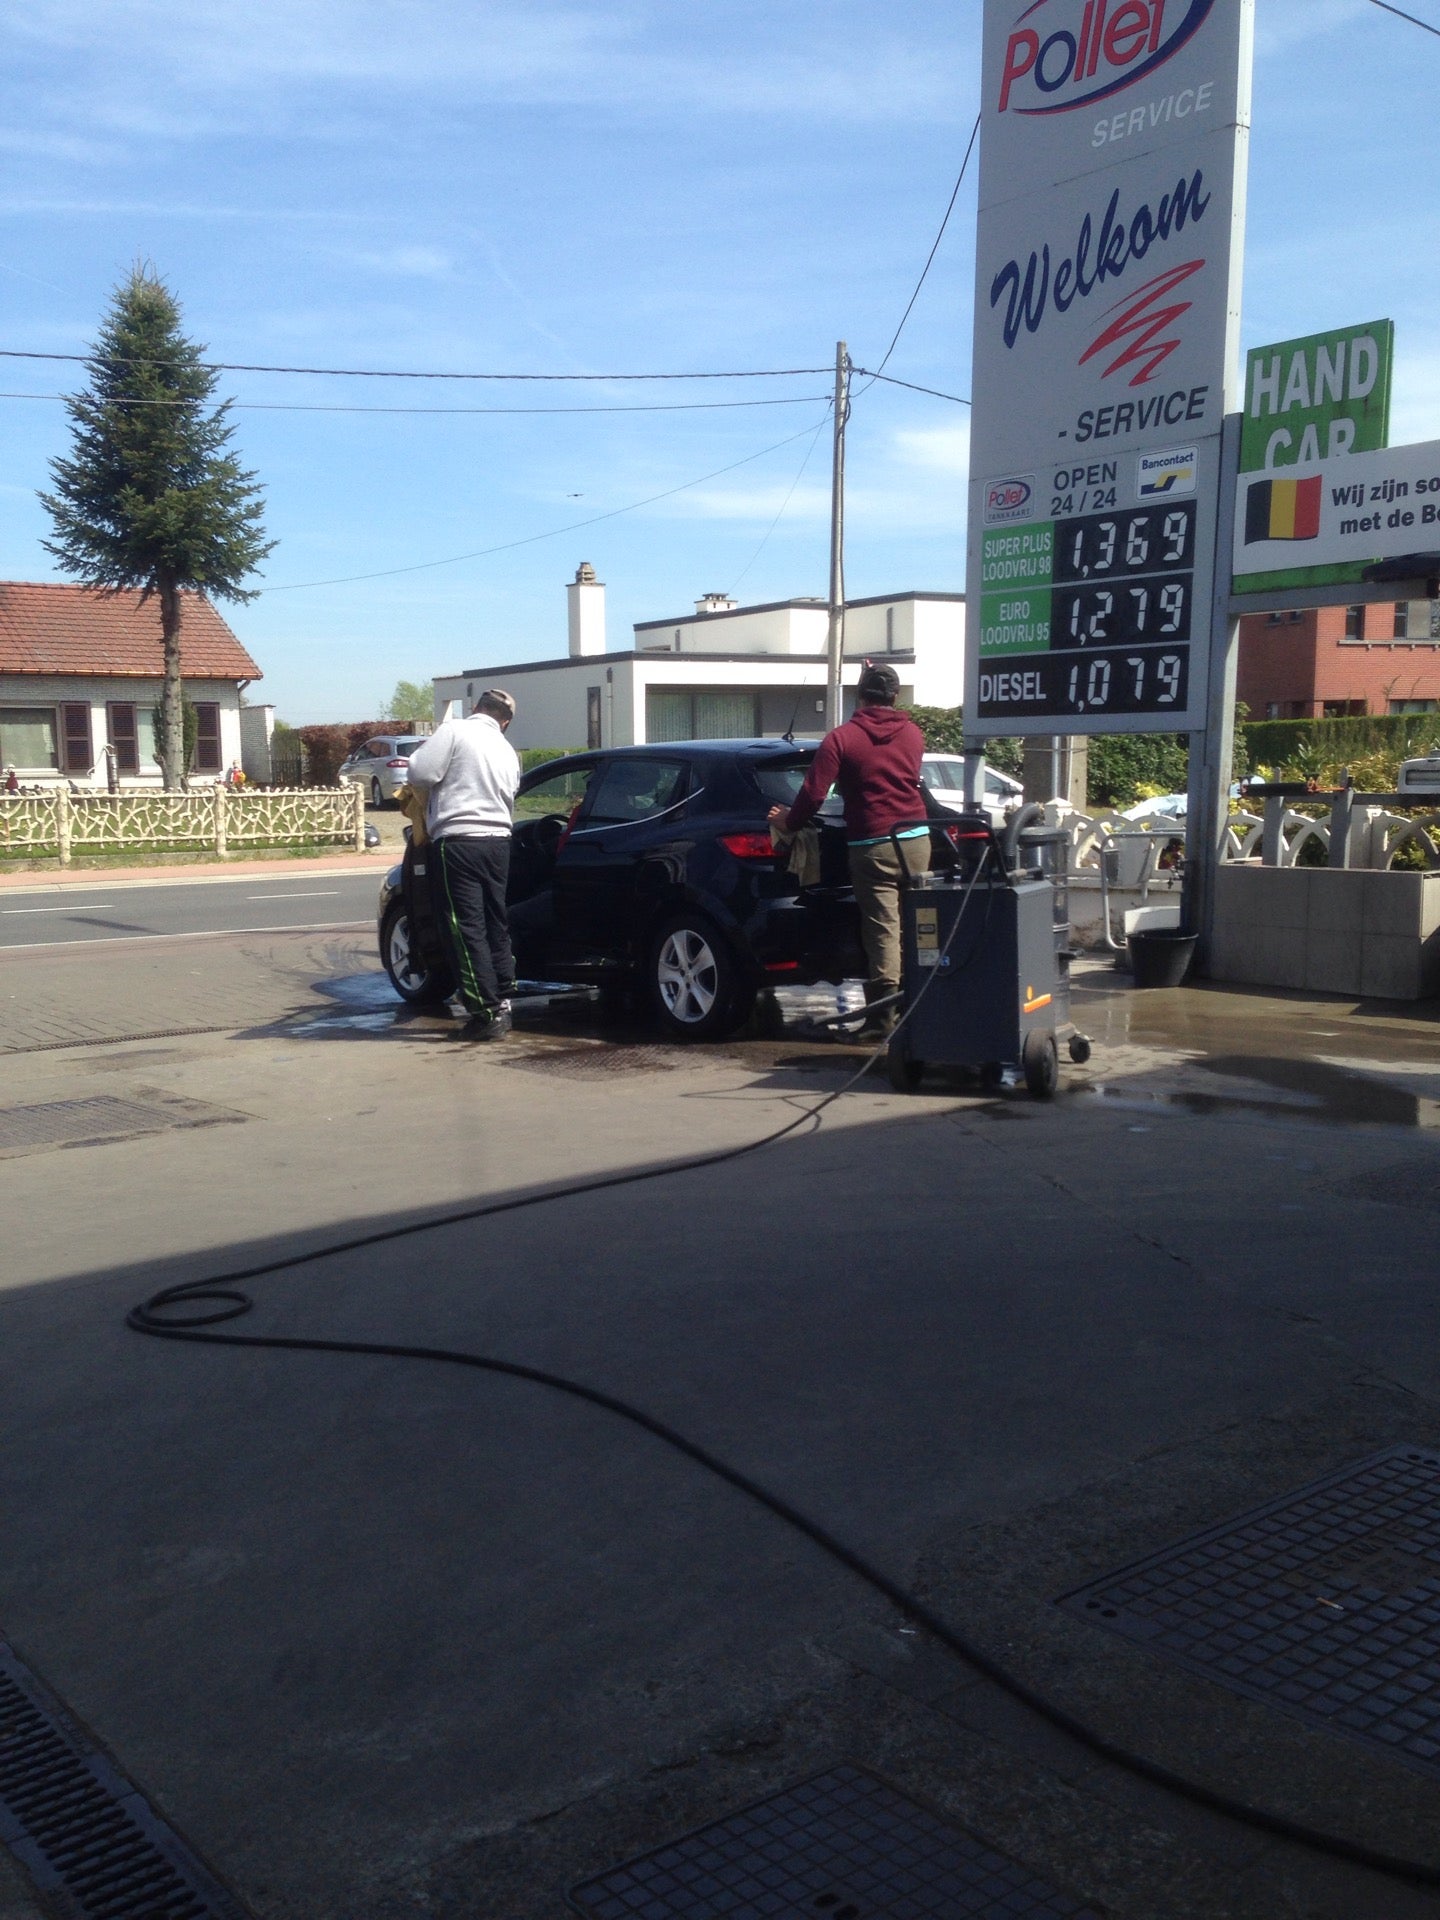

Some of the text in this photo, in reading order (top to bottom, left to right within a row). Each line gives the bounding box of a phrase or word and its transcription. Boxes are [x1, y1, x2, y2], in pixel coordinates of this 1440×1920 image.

[1091, 81, 1214, 148] SERVICE
[990, 169, 1211, 348] Welkom
[1251, 335, 1379, 418] HAND
[1075, 386, 1209, 443] SERVICE
[1265, 418, 1356, 470] CAR
[1054, 461, 1117, 491] OPEN
[1142, 452, 1194, 470] Bancontact
[988, 486, 1025, 508] Pollet
[1050, 494, 1074, 516] 24
[1092, 487, 1118, 509] 24
[1331, 483, 1365, 508] Wij
[1369, 479, 1409, 503] zijn
[1340, 511, 1382, 535] met
[1387, 508, 1415, 528] de
[985, 532, 1051, 558] SUPER PLUS
[1072, 512, 1188, 578] 1,369
[983, 556, 1051, 581] LOODVRIJ 98
[1000, 601, 1030, 621] EURO
[1070, 584, 1184, 646] 1,279
[981, 622, 1049, 645] LOODVRIJ 95
[979, 672, 1047, 702] DIESEL
[1068, 655, 1181, 713] 1,079
